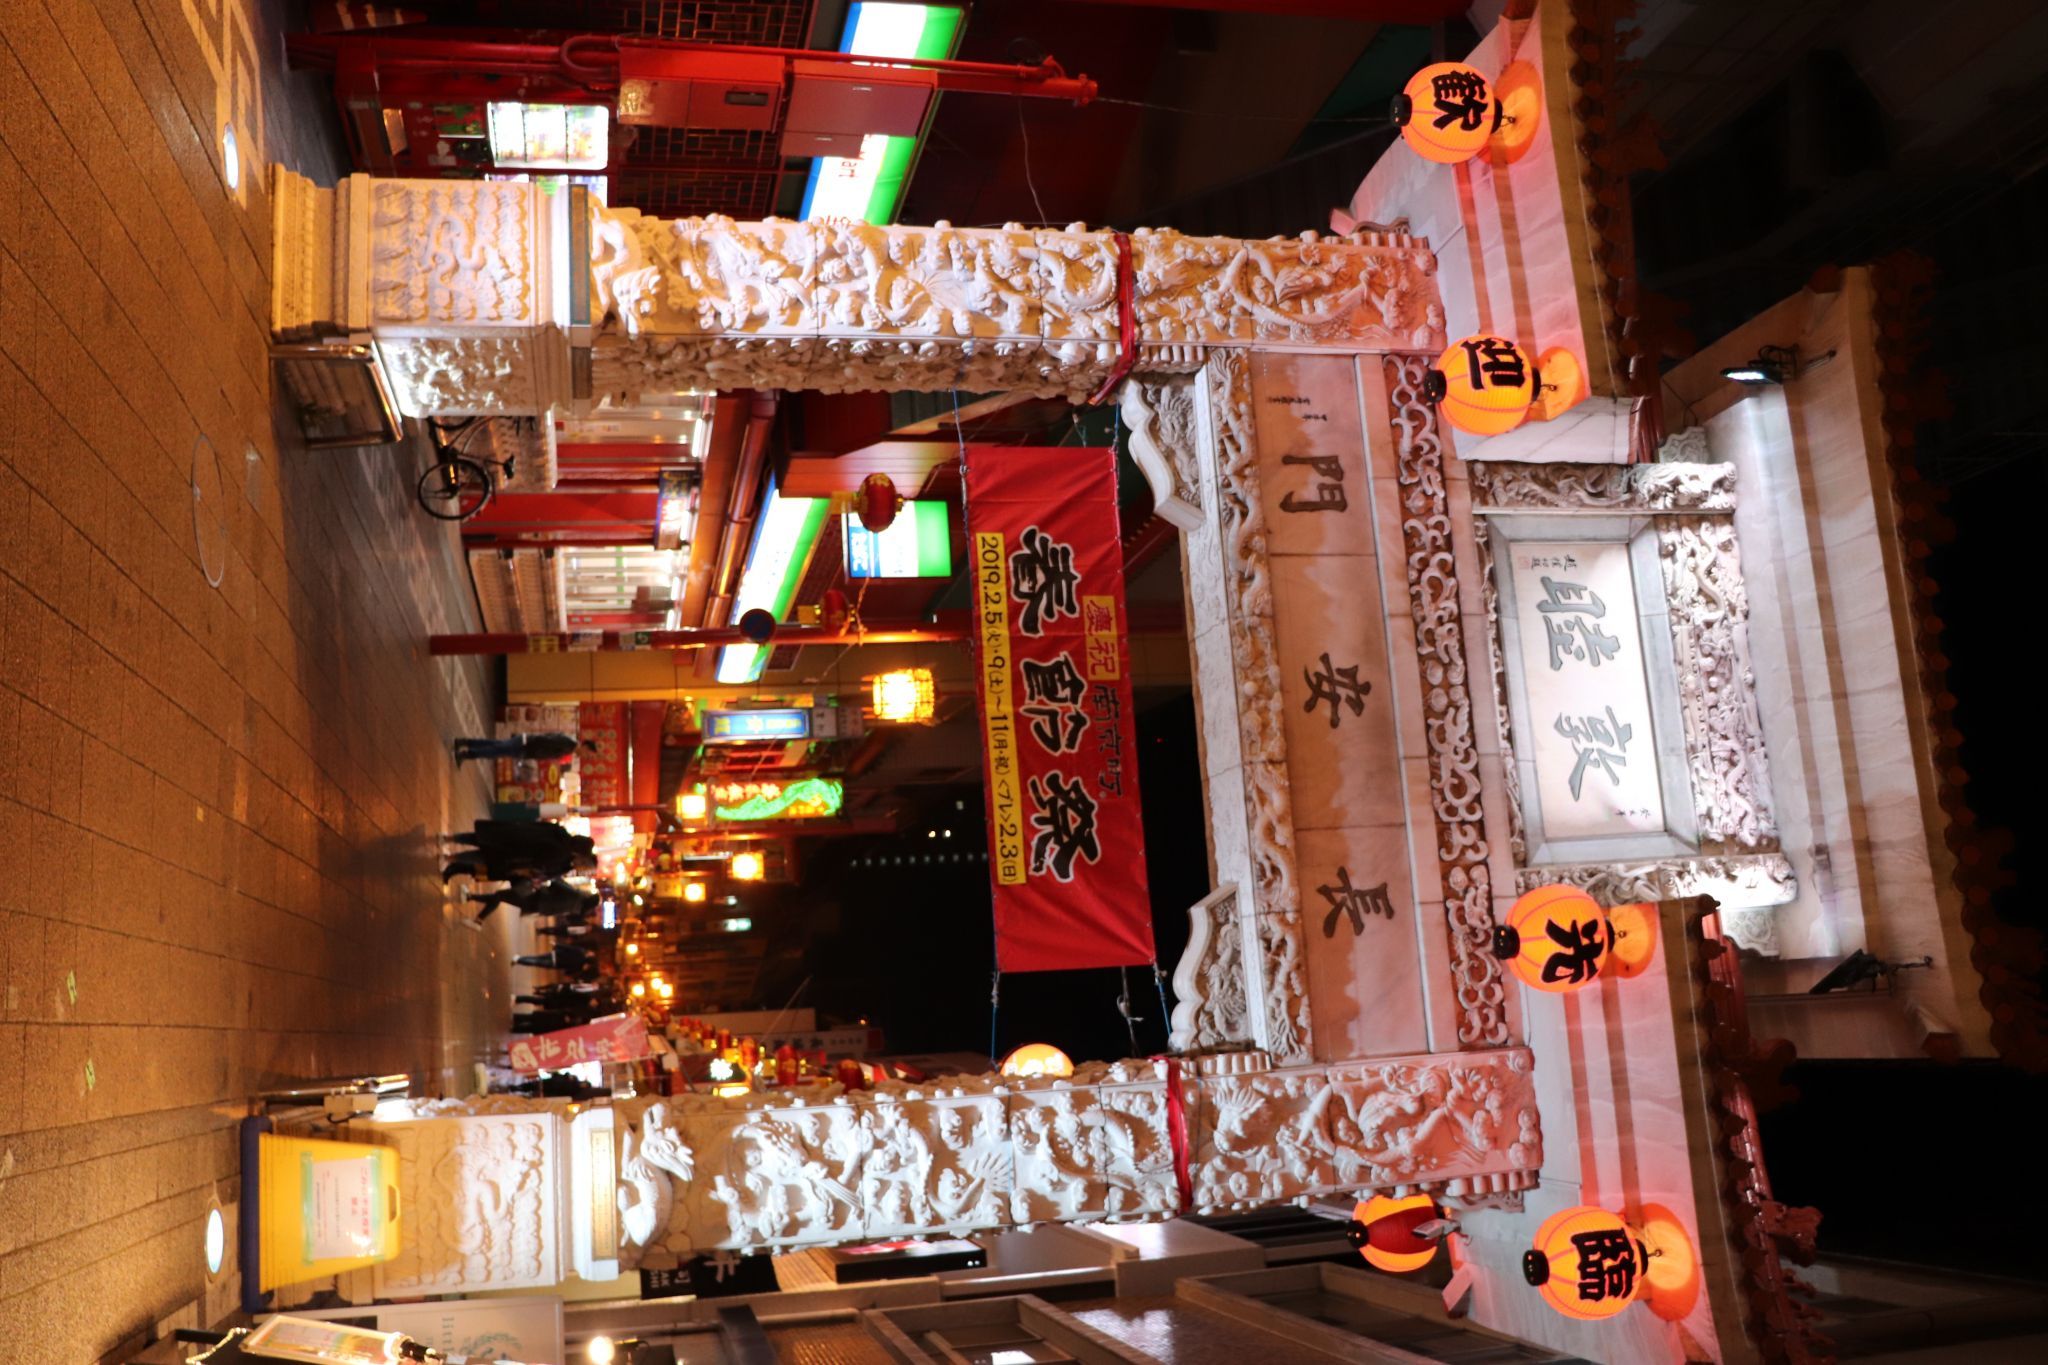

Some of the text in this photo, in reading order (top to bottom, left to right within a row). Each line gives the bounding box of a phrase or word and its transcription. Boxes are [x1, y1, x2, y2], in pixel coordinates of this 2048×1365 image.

[1431, 70, 1489, 131] 歓
[1460, 338, 1526, 391] 迎
[1010, 527, 1101, 881] 春節祭
[1085, 599, 1122, 797] 慶祝 南京町
[1279, 454, 1395, 939] 長安門
[1536, 575, 1633, 802] 敦睦
[1541, 918, 1604, 985] 光
[1570, 1227, 1637, 1302] 臨
